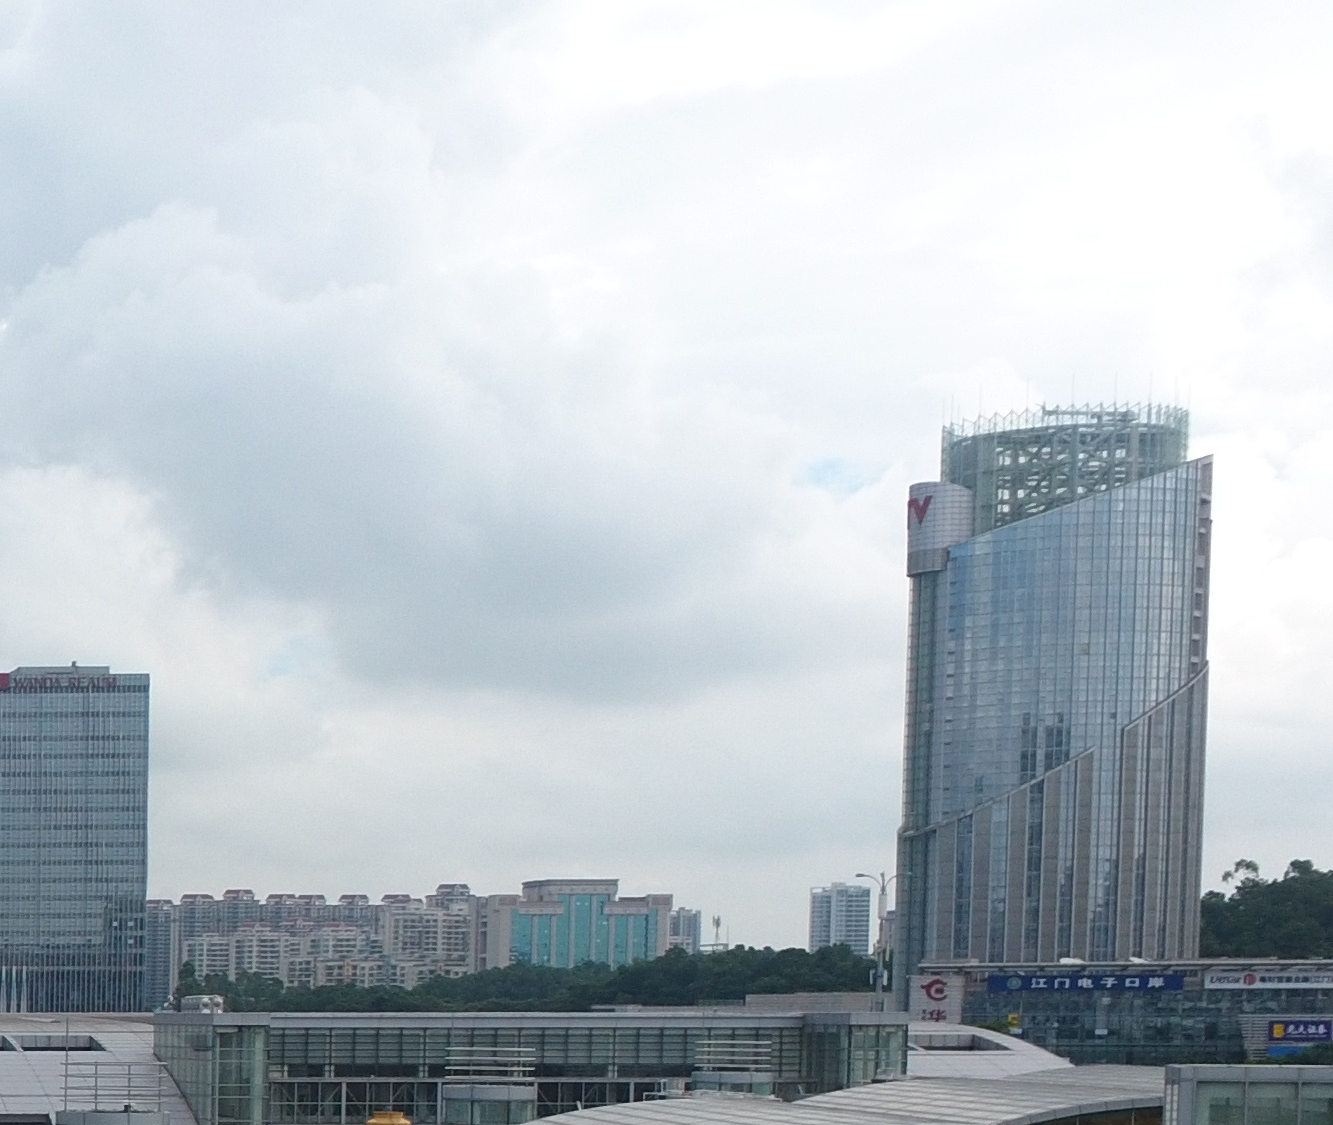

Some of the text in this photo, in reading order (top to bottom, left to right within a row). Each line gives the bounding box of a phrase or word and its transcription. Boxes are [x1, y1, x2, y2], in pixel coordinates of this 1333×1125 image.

[1030, 977, 1166, 989] 江门电子口岸
